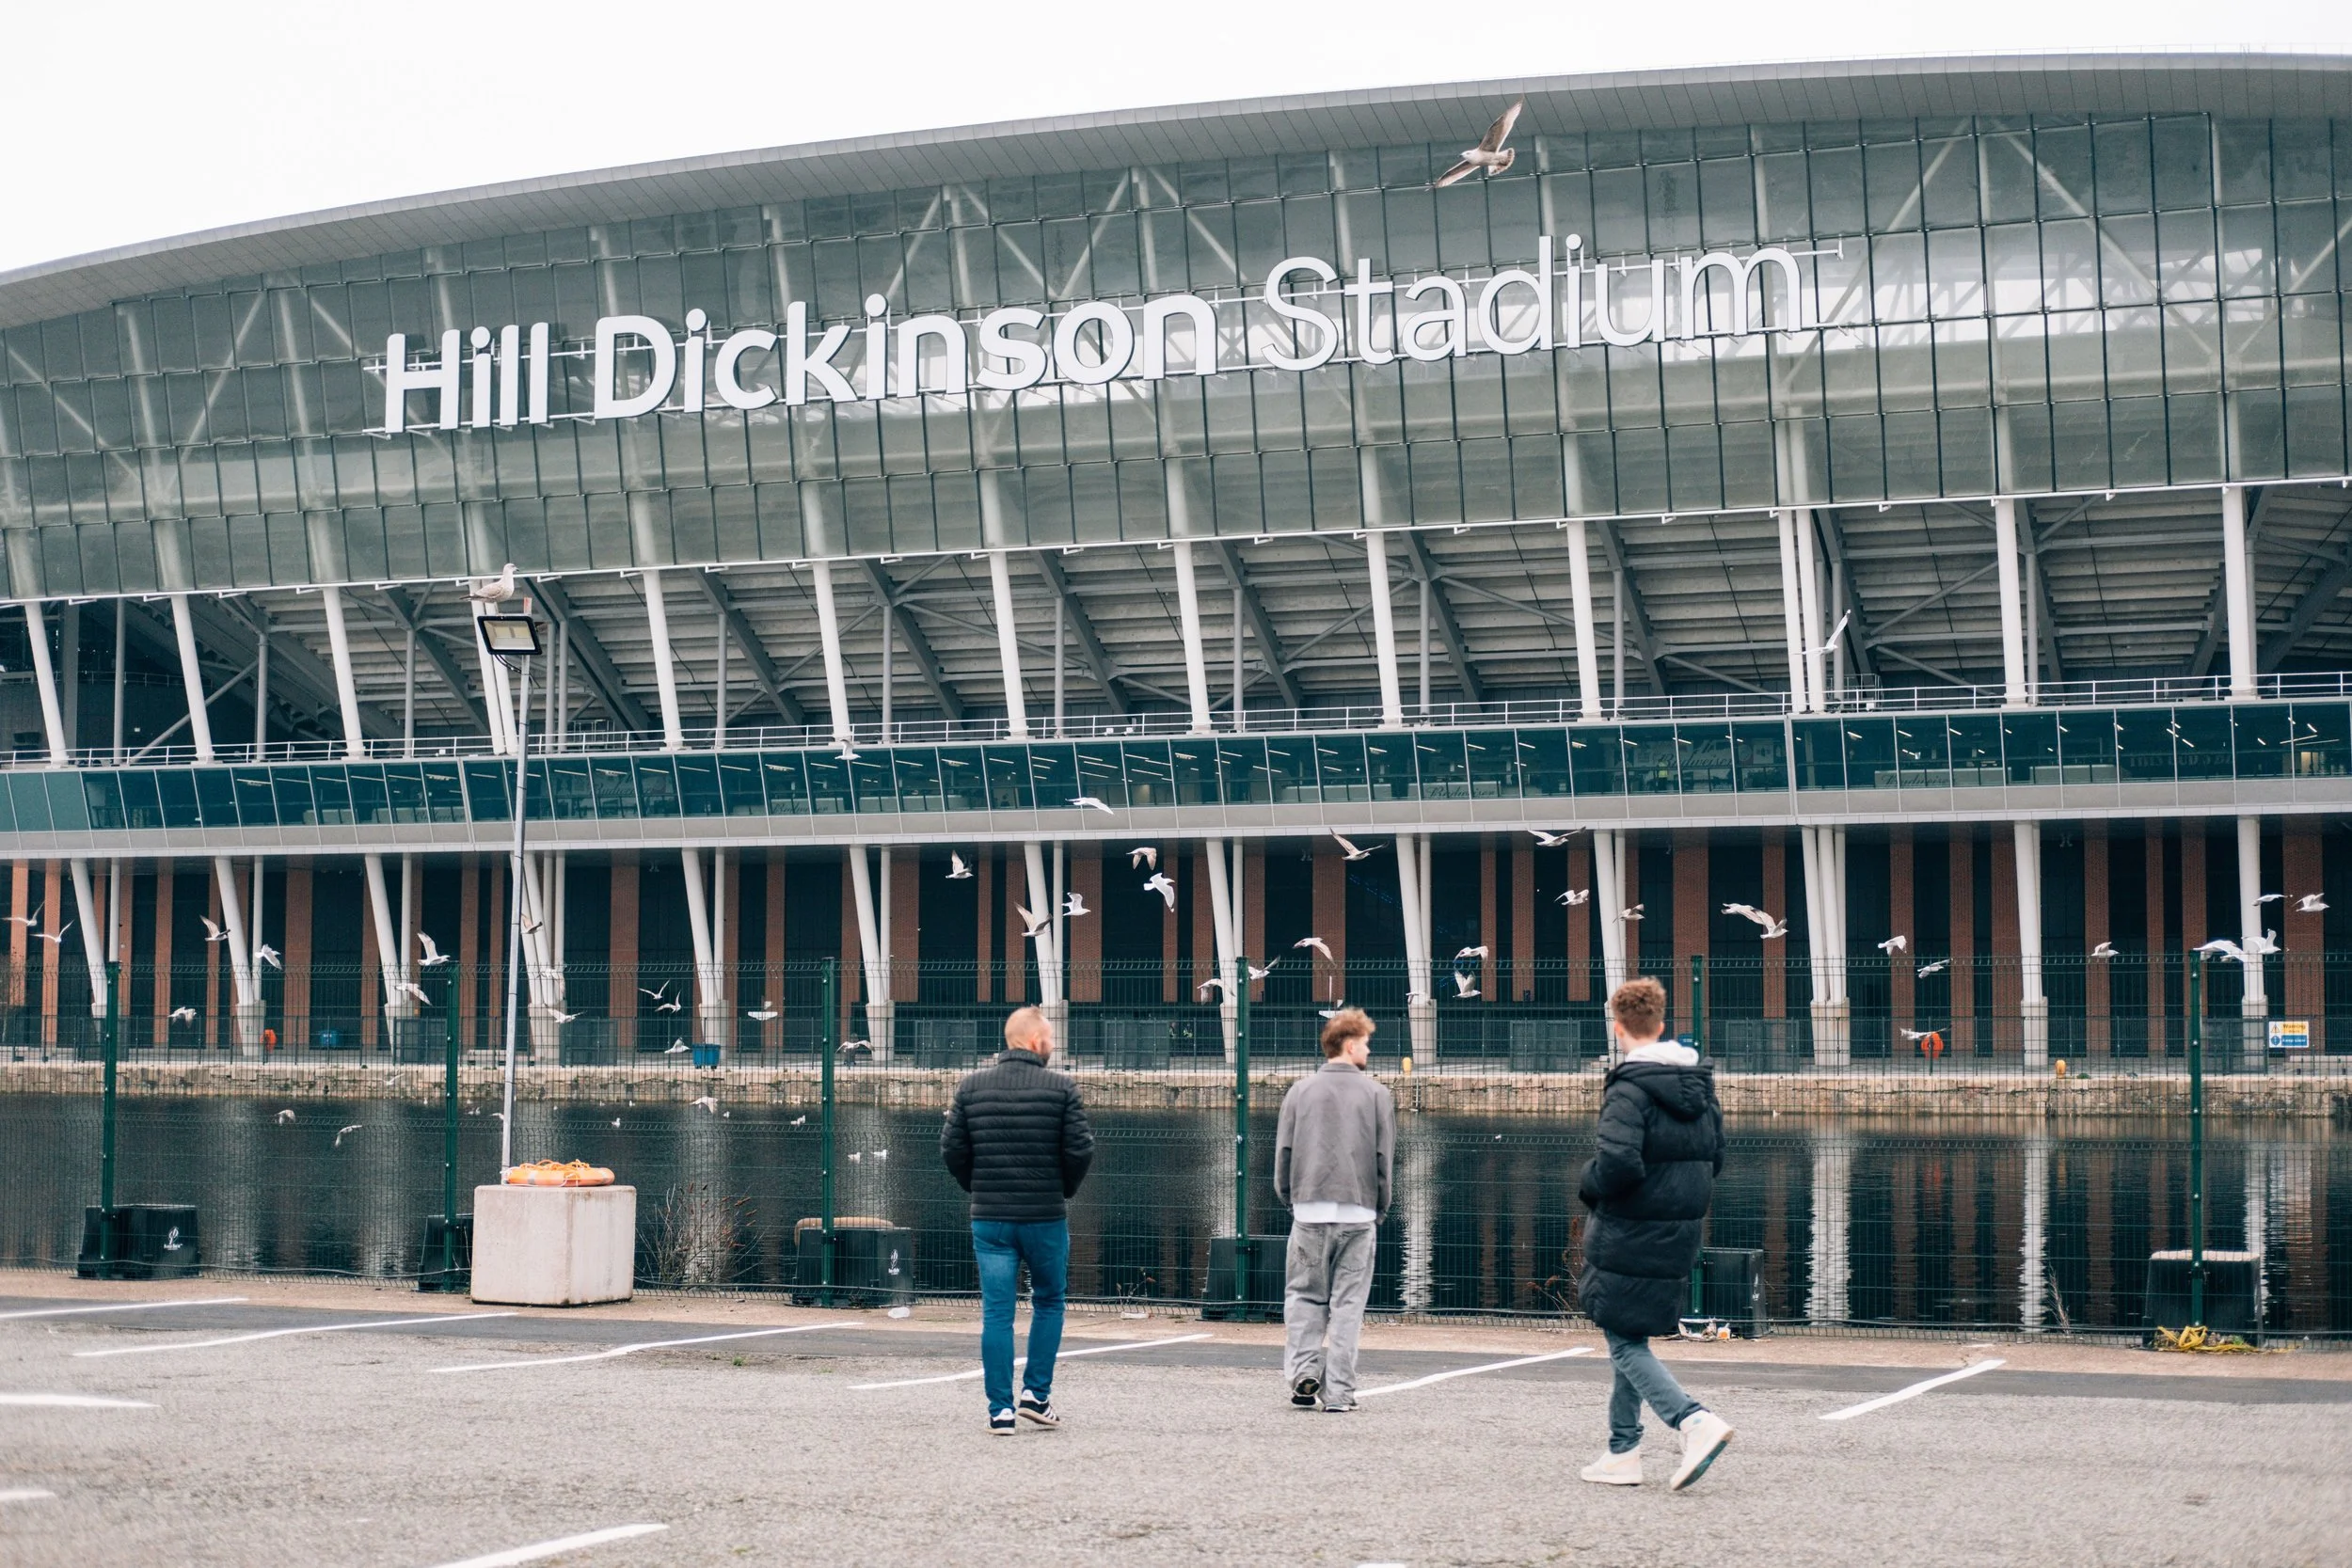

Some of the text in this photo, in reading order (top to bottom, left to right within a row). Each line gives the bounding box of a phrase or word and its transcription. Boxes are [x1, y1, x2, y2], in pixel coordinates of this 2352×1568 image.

[385, 233, 1803, 435] Hill Dickinson Stadium
[1882, 774, 1952, 786] Budweise
[1429, 785, 1496, 798] Budwiser
